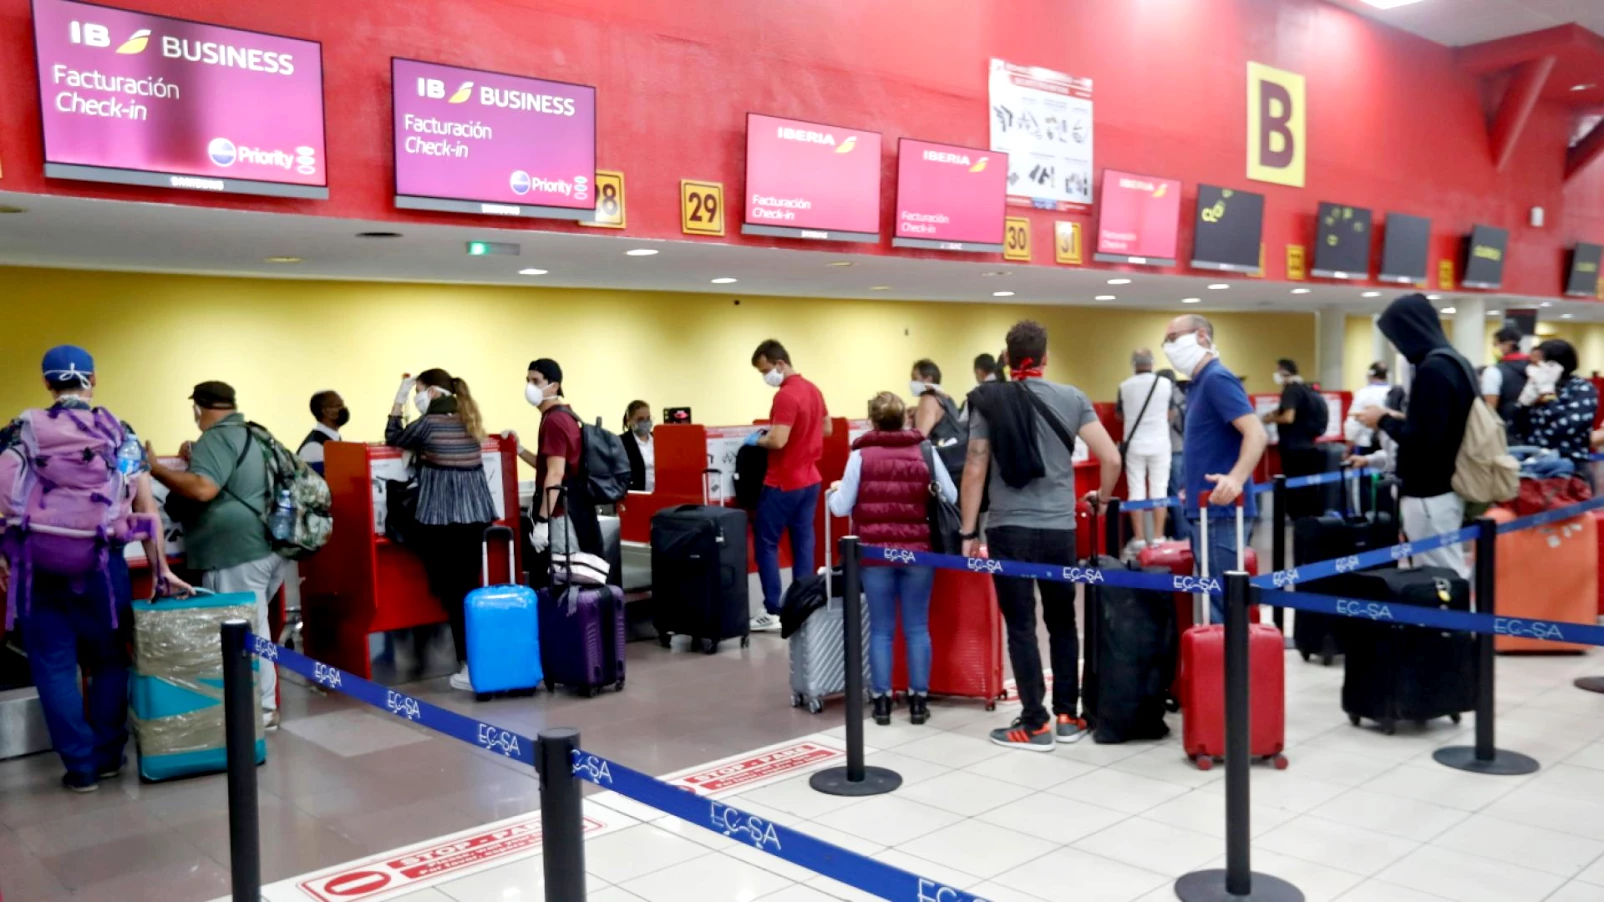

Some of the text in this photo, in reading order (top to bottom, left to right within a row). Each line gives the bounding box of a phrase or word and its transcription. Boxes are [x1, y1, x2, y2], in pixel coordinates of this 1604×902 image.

[68, 21, 295, 76] IB BUSINESS
[53, 64, 180, 100] Facturación
[56, 92, 148, 121] Check-in
[417, 77, 575, 117] IB BUSINESS
[404, 114, 493, 140] Facturación
[777, 126, 836, 146] IBERIA
[1259, 79, 1294, 169] B
[238, 146, 295, 170] Priority
[405, 136, 469, 159] Check-in
[923, 150, 971, 166] IBERIA
[532, 176, 572, 196] Priority
[689, 192, 718, 224] 29
[1008, 226, 1027, 251] 30
[400, 840, 473, 867] STOP
